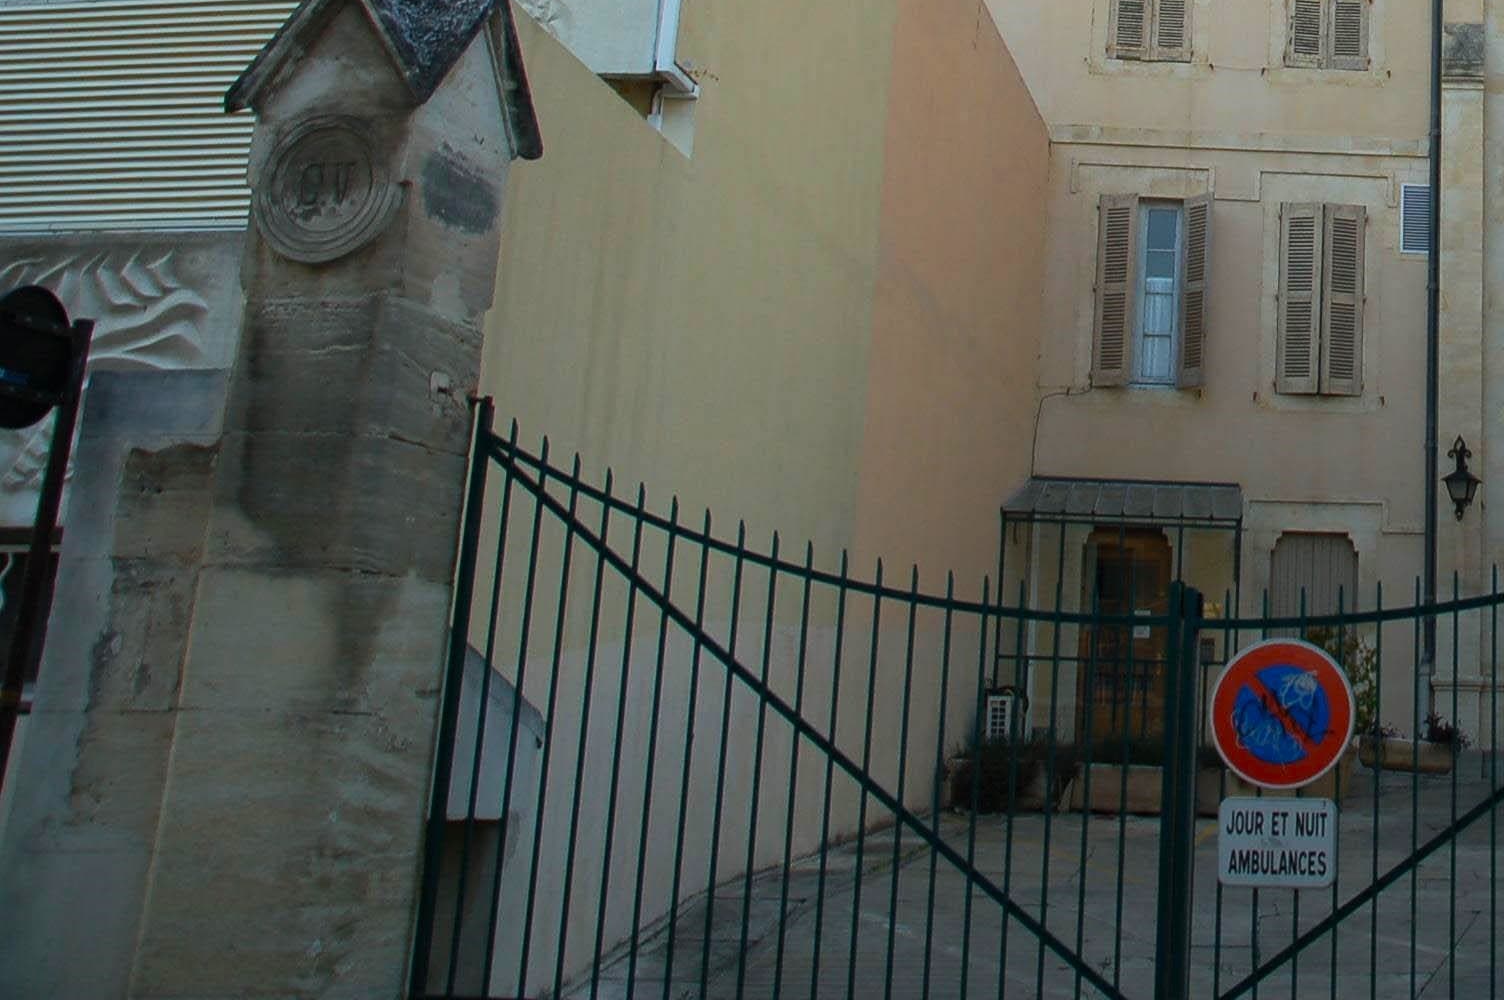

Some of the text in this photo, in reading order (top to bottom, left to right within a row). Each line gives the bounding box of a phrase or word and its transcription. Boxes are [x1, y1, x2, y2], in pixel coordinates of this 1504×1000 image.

[1226, 811, 1328, 838] JOUR ET NUIT
[1228, 850, 1327, 876] AMBULANCES
